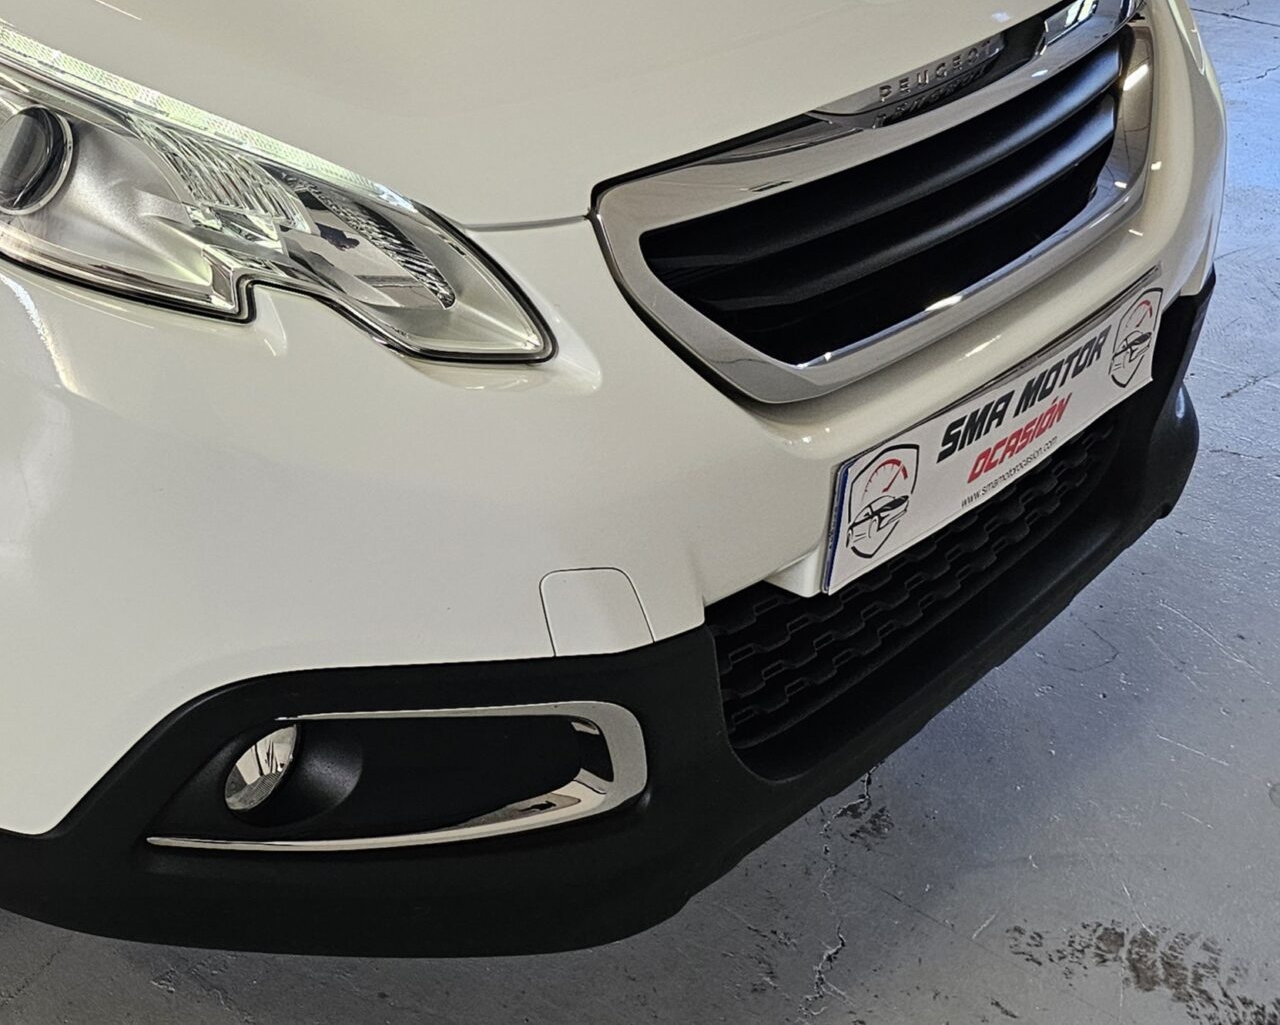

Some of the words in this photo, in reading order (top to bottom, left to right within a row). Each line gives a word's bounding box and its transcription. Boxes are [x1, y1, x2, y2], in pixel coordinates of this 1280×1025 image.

[879, 39, 992, 102] PEUGEOT
[936, 389, 1015, 464] SMA
[1012, 324, 1112, 419] MOTOR
[966, 392, 1072, 484] OCASIÓN
